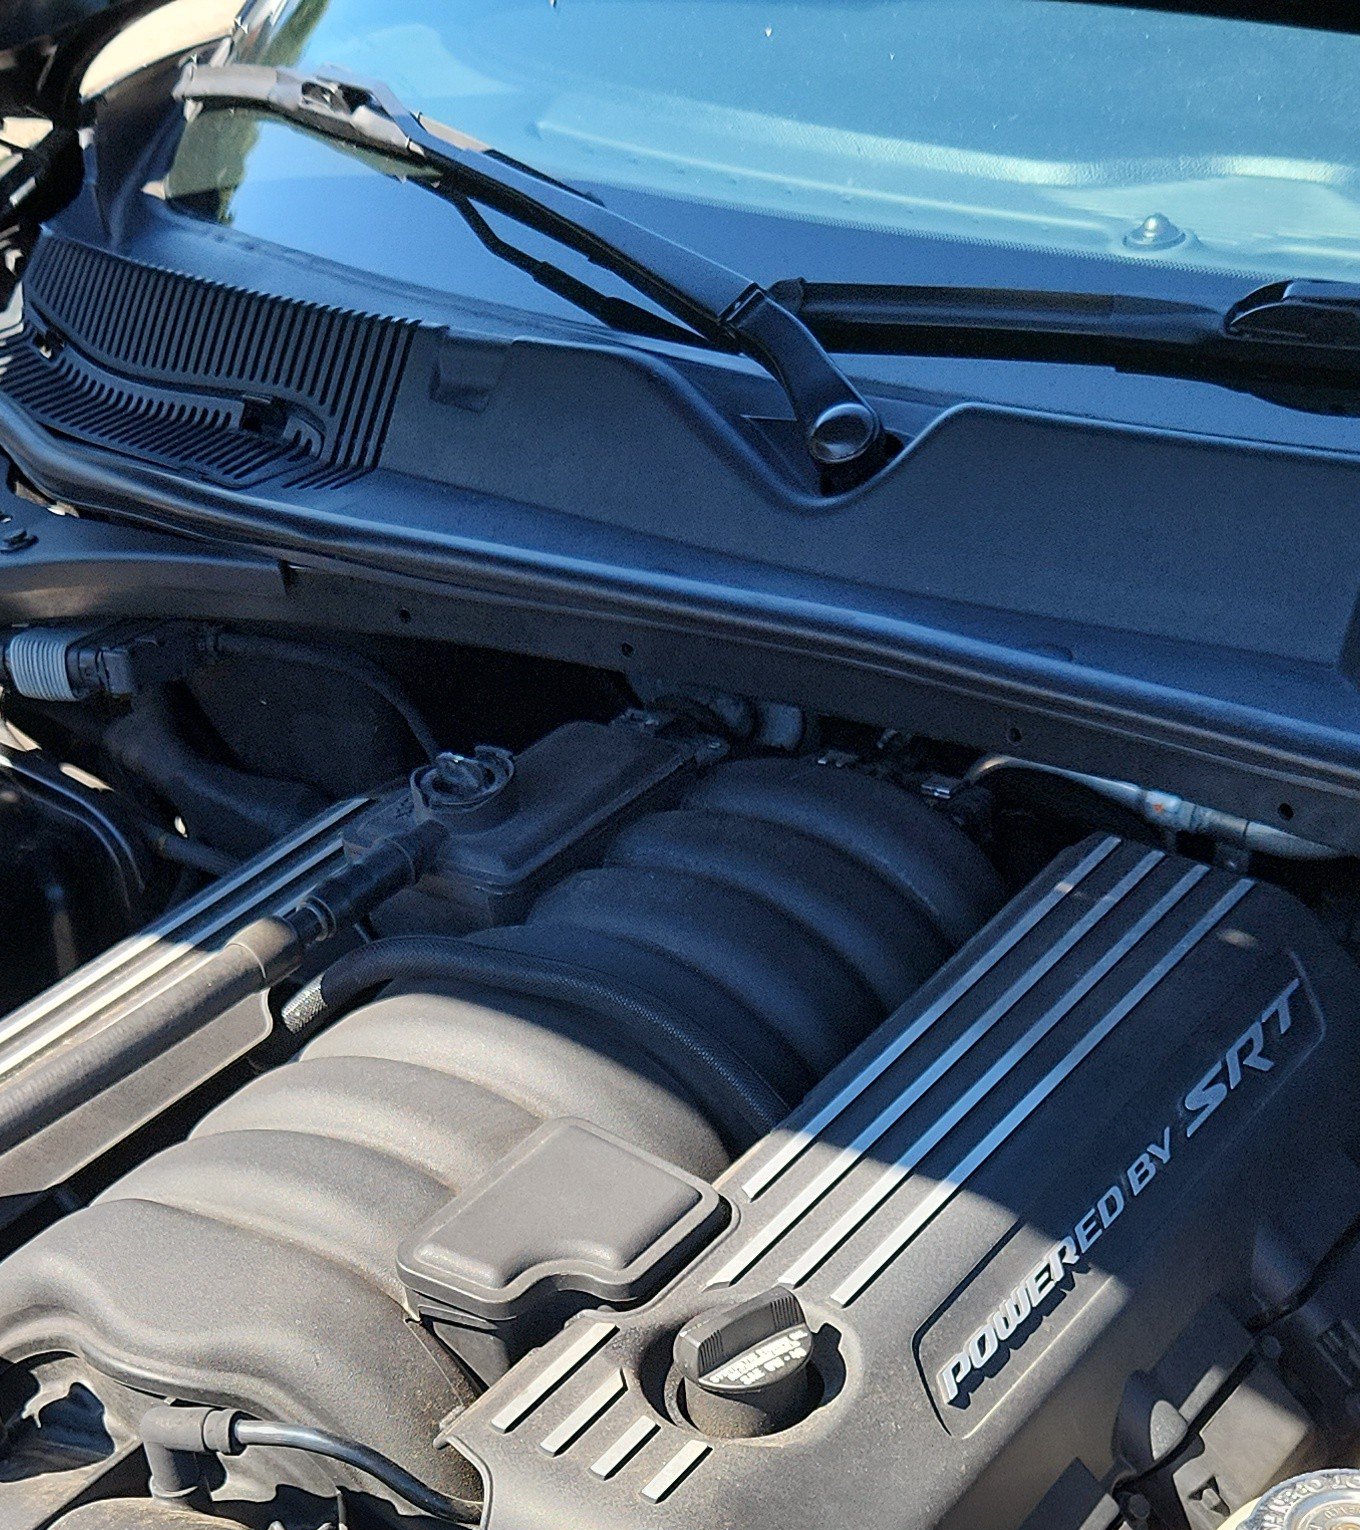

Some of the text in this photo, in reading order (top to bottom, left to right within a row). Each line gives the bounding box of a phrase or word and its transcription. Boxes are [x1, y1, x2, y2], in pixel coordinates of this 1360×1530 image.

[938, 979, 1301, 1405] POWERED BY SRT
